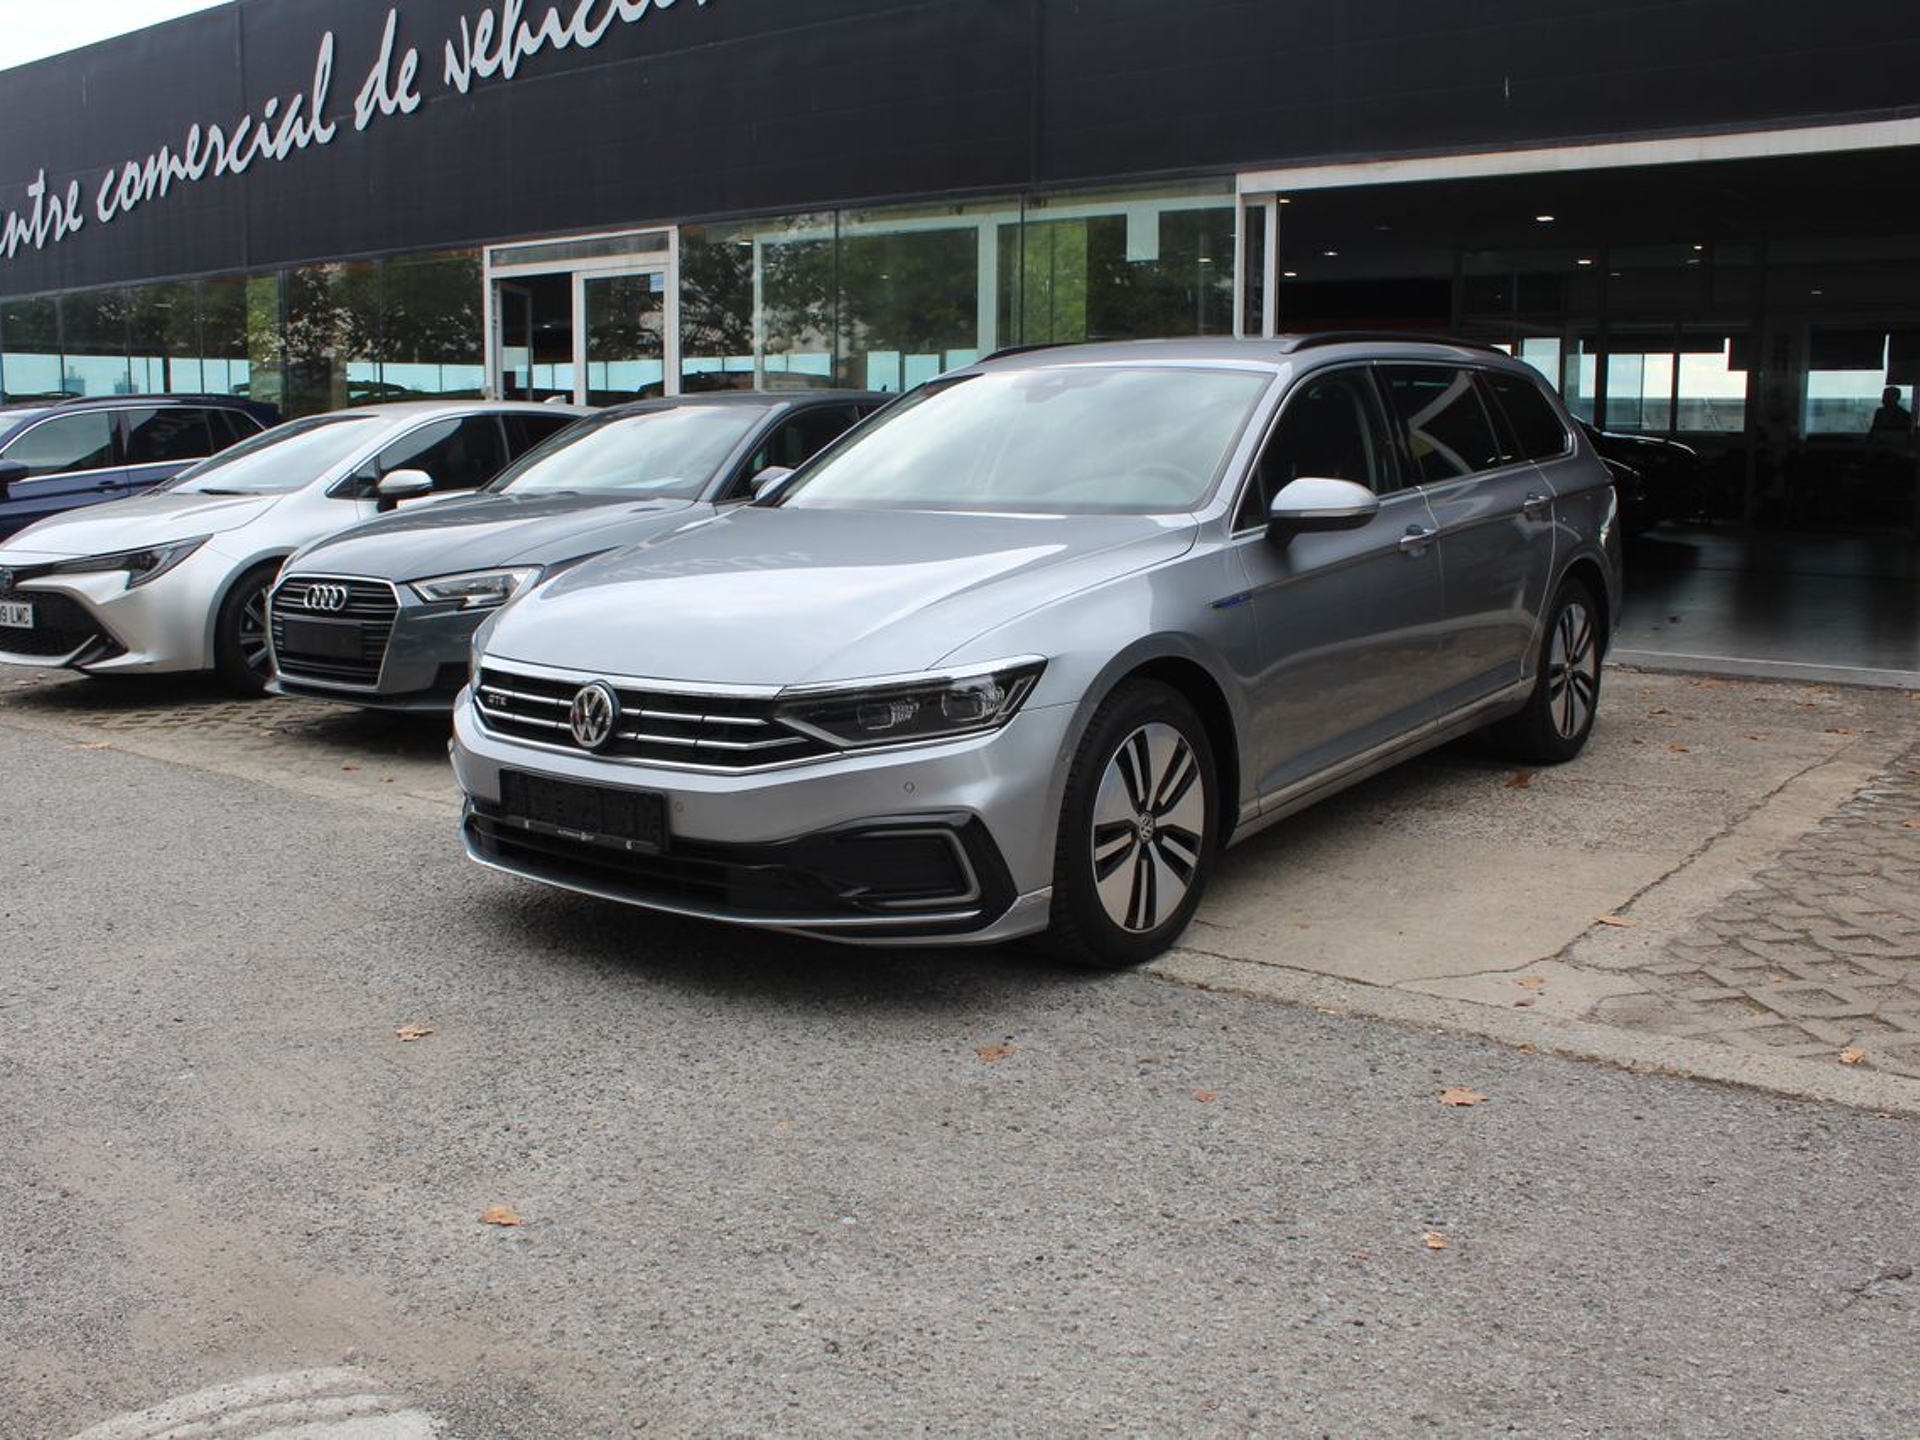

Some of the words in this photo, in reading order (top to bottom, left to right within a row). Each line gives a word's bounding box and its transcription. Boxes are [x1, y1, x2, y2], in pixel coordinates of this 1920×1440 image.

[0, 168, 83, 259] ntre
[97, 31, 336, 223] comercial
[354, 8, 421, 131] de
[444, 0, 704, 93] vehic
